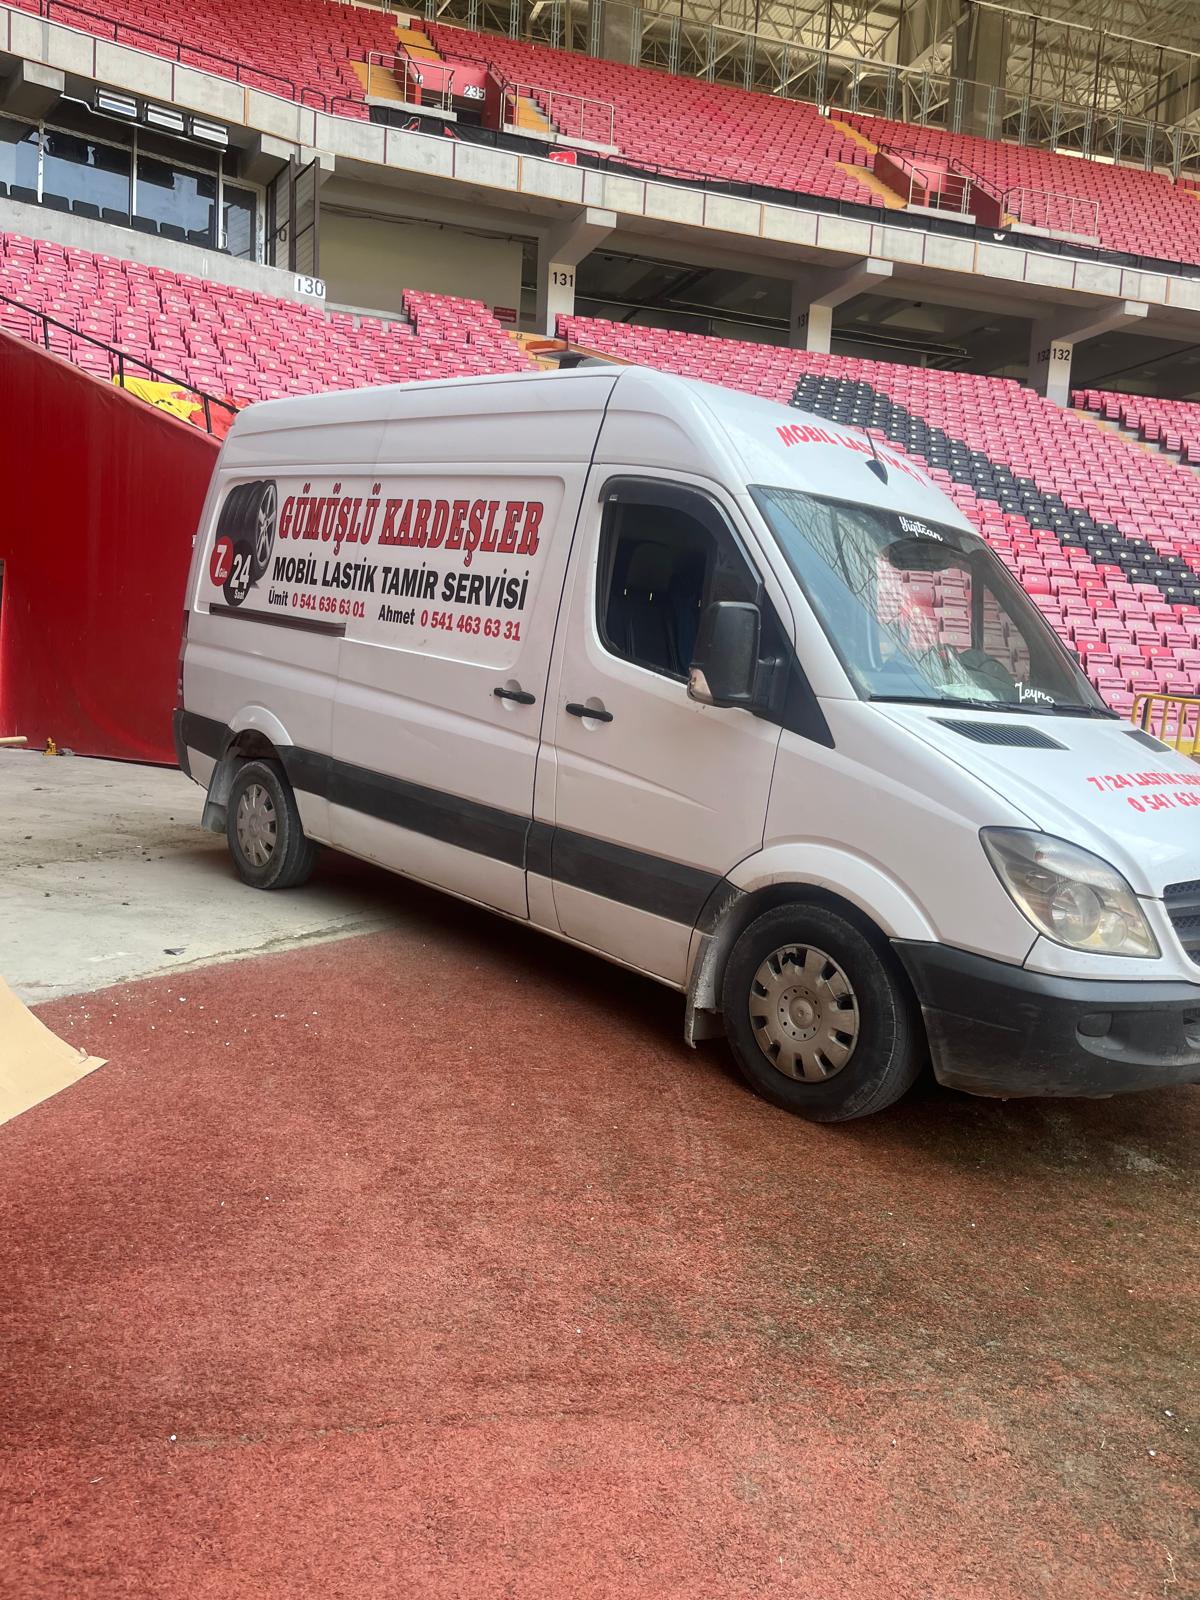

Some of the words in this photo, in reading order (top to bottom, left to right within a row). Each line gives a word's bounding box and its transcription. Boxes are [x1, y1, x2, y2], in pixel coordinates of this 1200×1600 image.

[464, 84, 485, 99] 235
[298, 277, 324, 297] 130
[553, 271, 574, 287] 131
[1053, 348, 1070, 361] 132
[278, 482, 381, 556] GÜMÜŞLÜ
[378, 498, 544, 567] KARDEŞLER
[214, 544, 228, 578] 7
[229, 553, 252, 590] 24
[272, 552, 318, 585] MOBİL
[321, 556, 378, 593] LASTİK
[381, 561, 438, 600] TAMİR
[441, 567, 530, 610] SERVİSİ
[268, 586, 288, 606] Ümit
[292, 592, 298, 608] 0
[299, 593, 316, 610] 541
[318, 596, 337, 613] 636
[338, 598, 351, 615] 63
[352, 601, 365, 618] 01
[378, 604, 416, 625] Ahmet
[420, 609, 429, 627] 0
[430, 611, 454, 631] 541
[456, 614, 481, 635] 463
[483, 618, 500, 637] 63
[503, 621, 521, 641] 31
[1127, 797, 1146, 812] 0
[1141, 794, 1176, 810] 541
